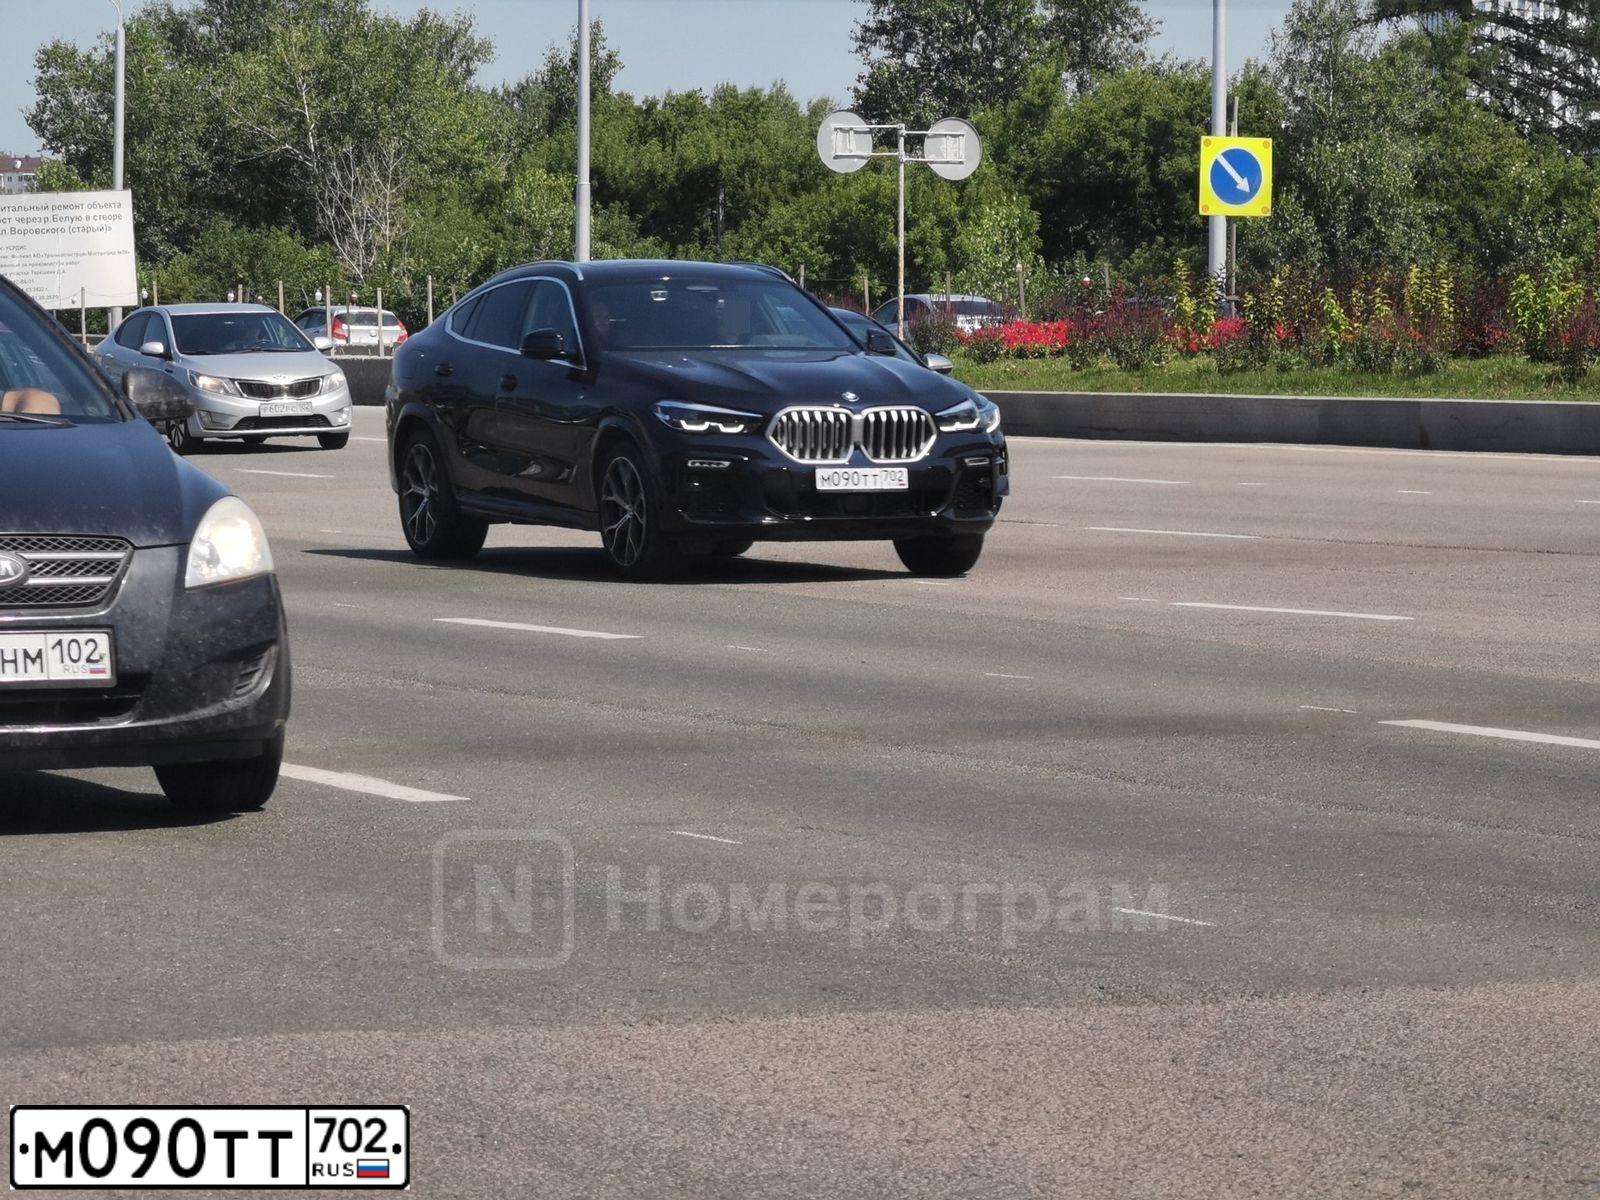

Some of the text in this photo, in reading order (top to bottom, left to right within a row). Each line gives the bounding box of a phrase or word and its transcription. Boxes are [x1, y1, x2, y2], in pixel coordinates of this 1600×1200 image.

[52, 203, 84, 212] ремонт
[87, 200, 121, 209] объекта
[93, 213, 122, 221] створе
[821, 470, 904, 486] М090ТТ 702
[51, 638, 98, 664] 102
[63, 665, 88, 674] RUS
